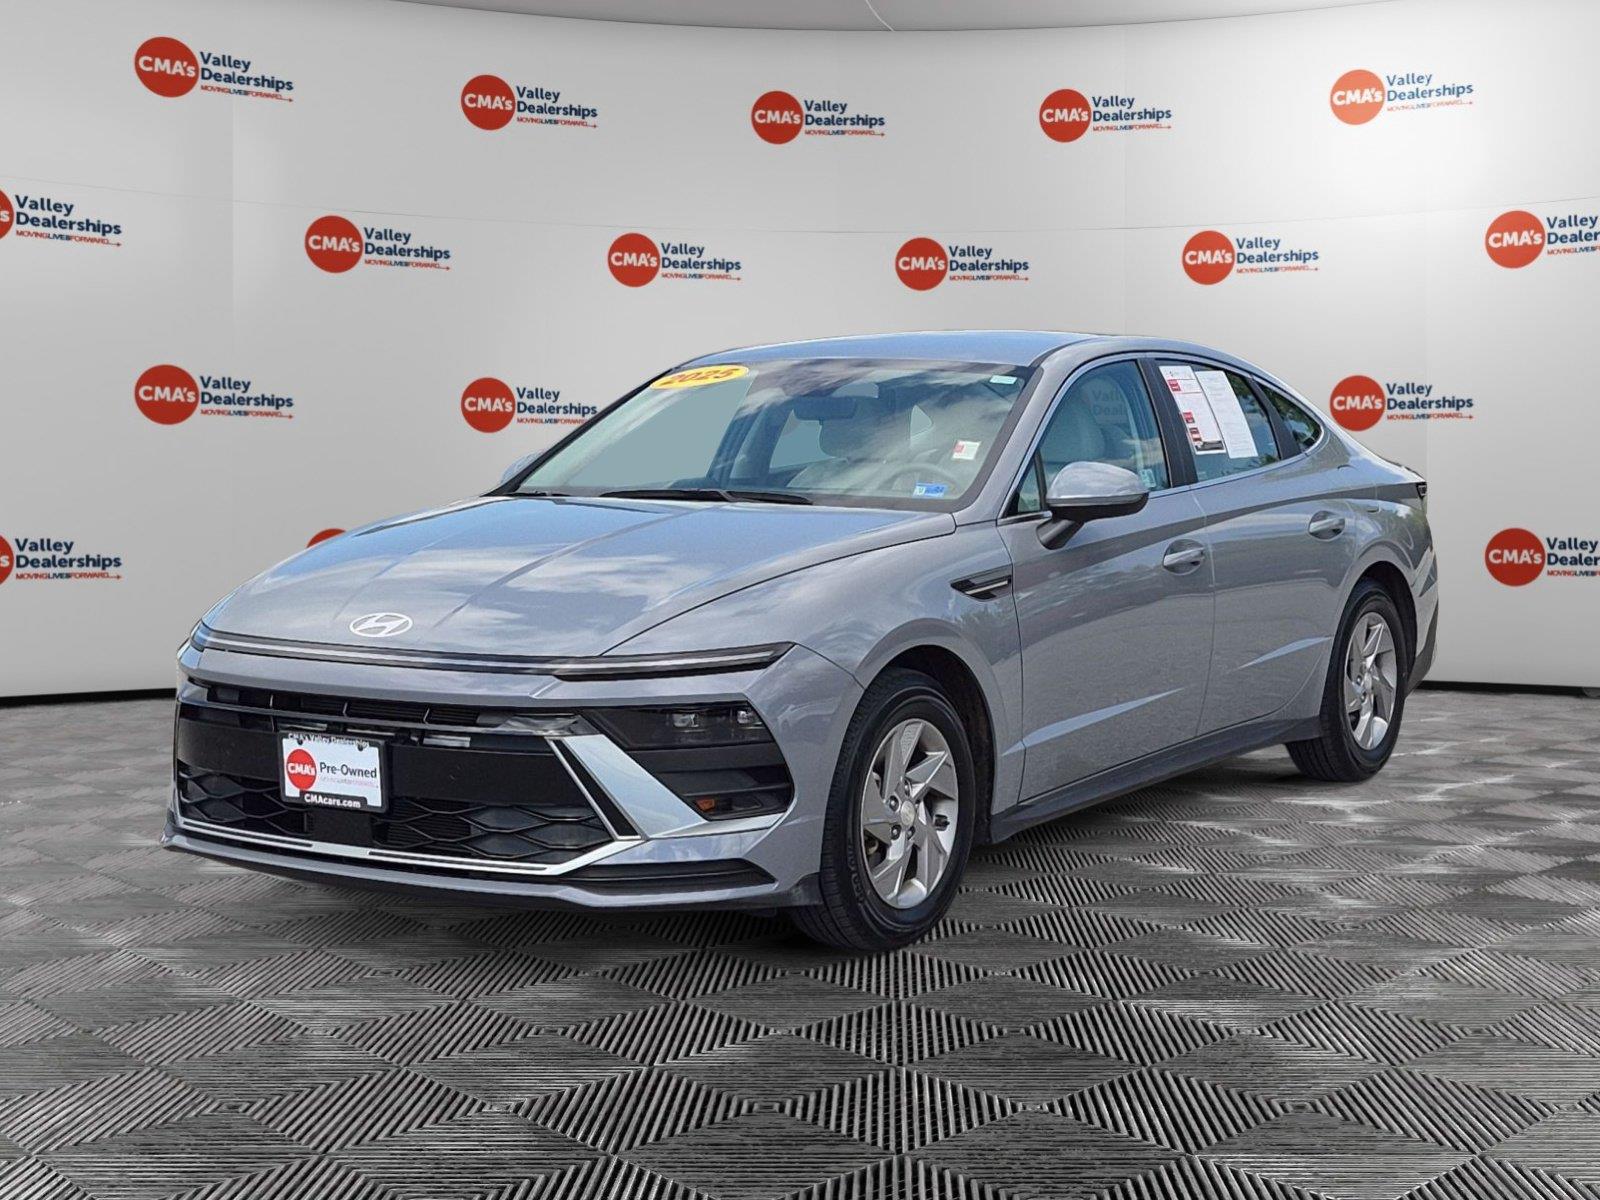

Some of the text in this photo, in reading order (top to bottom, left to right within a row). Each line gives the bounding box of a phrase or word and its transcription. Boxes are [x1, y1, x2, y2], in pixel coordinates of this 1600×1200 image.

[138, 56, 196, 77] CMA's
[200, 51, 251, 72] Valley
[201, 68, 293, 92] Dealerships
[1386, 73, 1432, 86] Valley
[516, 86, 560, 103] Valley
[1332, 88, 1382, 106] CMA's
[1387, 84, 1474, 102] Dealerships
[464, 94, 512, 110] CMA's
[804, 100, 847, 114] Valley
[1092, 96, 1135, 109] Valley
[517, 101, 598, 119] Dealerships
[755, 110, 800, 124] CMA's
[1042, 108, 1088, 122] CMA's
[1093, 108, 1172, 122] Dealerships
[805, 114, 885, 128] Dealerships
[15, 194, 74, 216] Valley
[16, 212, 122, 236] Dealerships
[1546, 214, 1598, 229] Valley
[364, 227, 411, 244] Valley
[1488, 230, 1542, 248] CMA's
[308, 235, 360, 252] CMA's
[364, 242, 450, 260] Dealerships
[661, 242, 704, 258] Valley
[1236, 237, 1280, 250] Valley
[611, 252, 658, 267] CMA's
[949, 246, 992, 260] Valley
[1185, 250, 1232, 265] CMA's
[1236, 250, 1319, 264] Dealerships
[662, 258, 742, 272] Dealerships
[898, 256, 946, 270] CMA's
[950, 260, 1029, 273] Dealerships
[200, 376, 251, 394] Valley
[1386, 382, 1432, 397] Valley
[138, 386, 196, 402] CMA's
[201, 392, 293, 410] Dealerships
[516, 387, 560, 402] Valley
[464, 397, 512, 412] CMA's
[517, 402, 598, 417] Dealerships
[1333, 396, 1382, 410] CMA's
[1387, 396, 1474, 411] Dealerships
[15, 538, 74, 554] Valley
[1546, 537, 1598, 554] Valley
[16, 554, 122, 570] Dealerships
[1488, 549, 1542, 564] CMA's
[288, 762, 316, 776] CMA's
[320, 762, 377, 778] Pre-Owned
[304, 794, 361, 808] CMAcars.com
